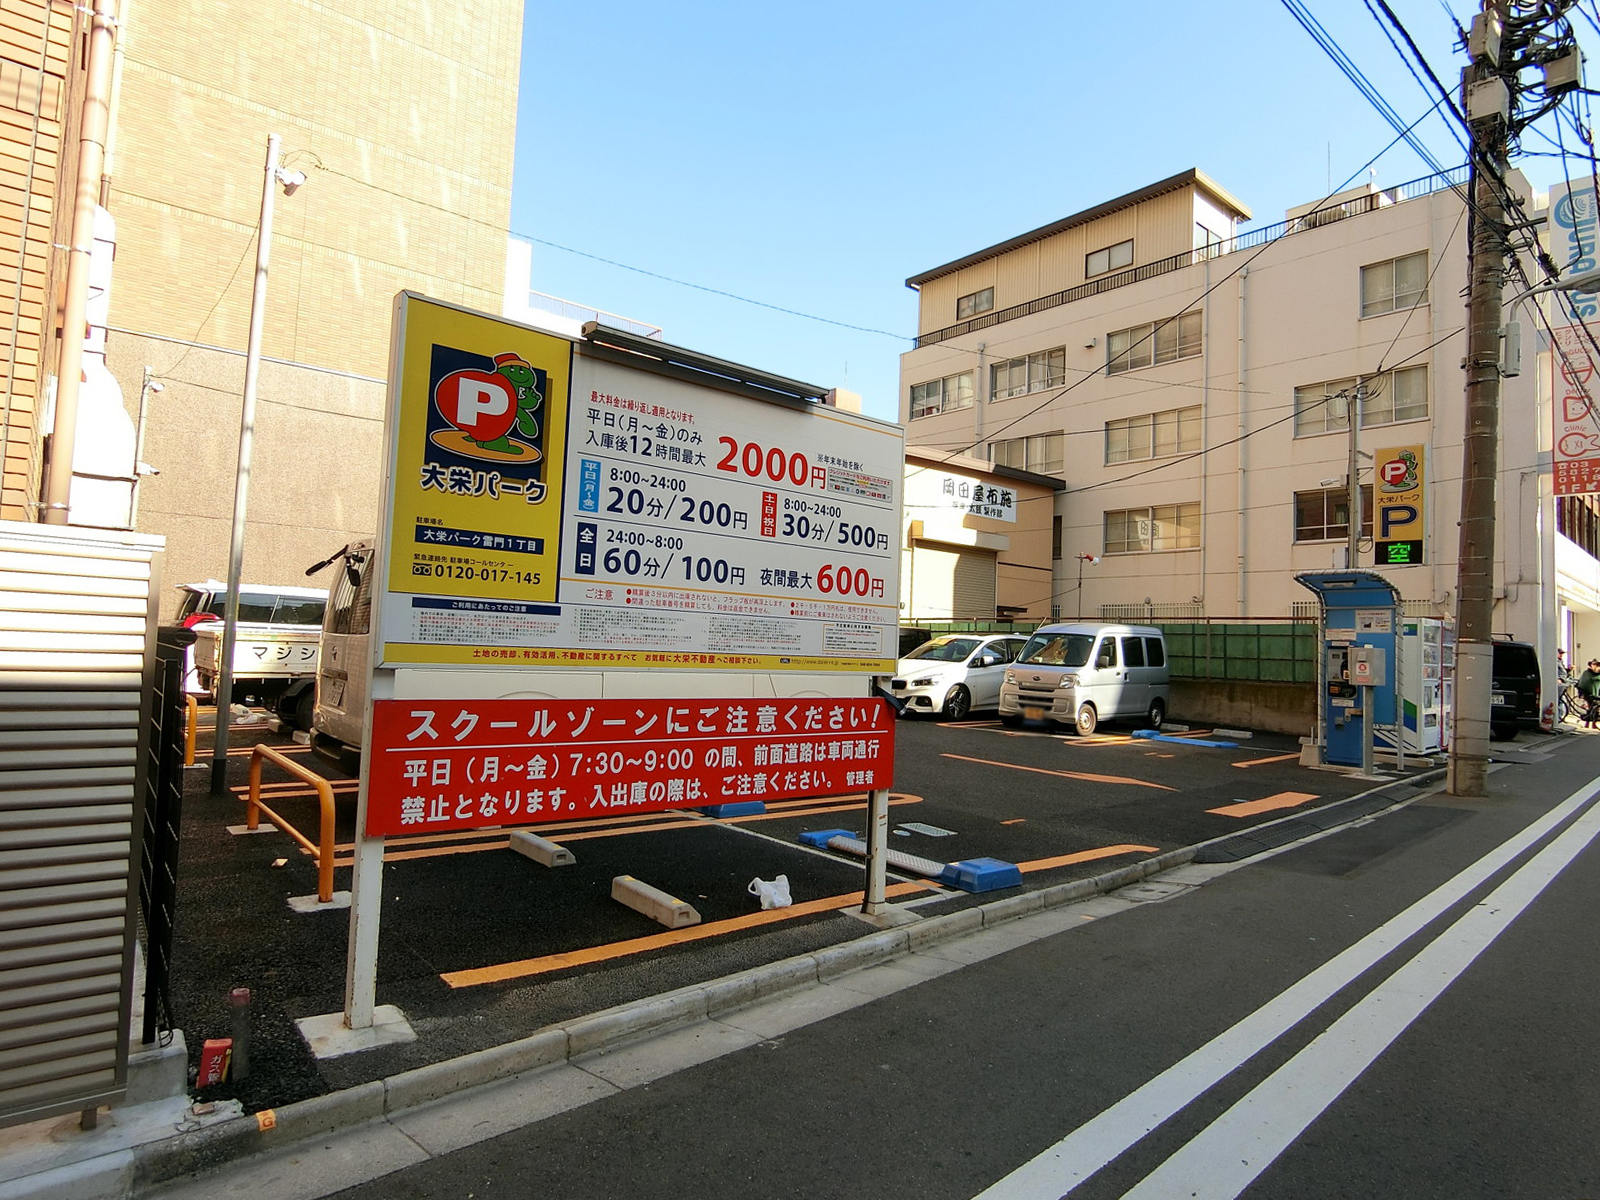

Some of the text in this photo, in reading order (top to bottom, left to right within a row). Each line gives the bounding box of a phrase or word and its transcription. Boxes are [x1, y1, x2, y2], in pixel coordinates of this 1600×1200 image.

[457, 377, 509, 426] P
[1564, 425, 1588, 433] Clinic
[586, 429, 826, 490] 入庫後12時間最大 2000円
[420, 464, 548, 505] 大栄パーク
[1377, 494, 1420, 504] 大栄パーク
[416, 516, 444, 526] 駐車場名
[1380, 504, 1420, 540] P
[782, 513, 889, 551] 30分/500円
[413, 553, 448, 563] 緊急連絡先
[1387, 542, 1411, 563] 空
[434, 564, 541, 585] 0120-017-145
[760, 564, 885, 599] 夜間最大 600円
[585, 588, 614, 601] ご注意
[451, 601, 527, 613] ご利用にあたってのご注意
[251, 646, 317, 661] マジシ
[473, 649, 638, 661] 土地の売却、有効活用、不動産に関するすべて
[846, 769, 874, 786] 管理者
